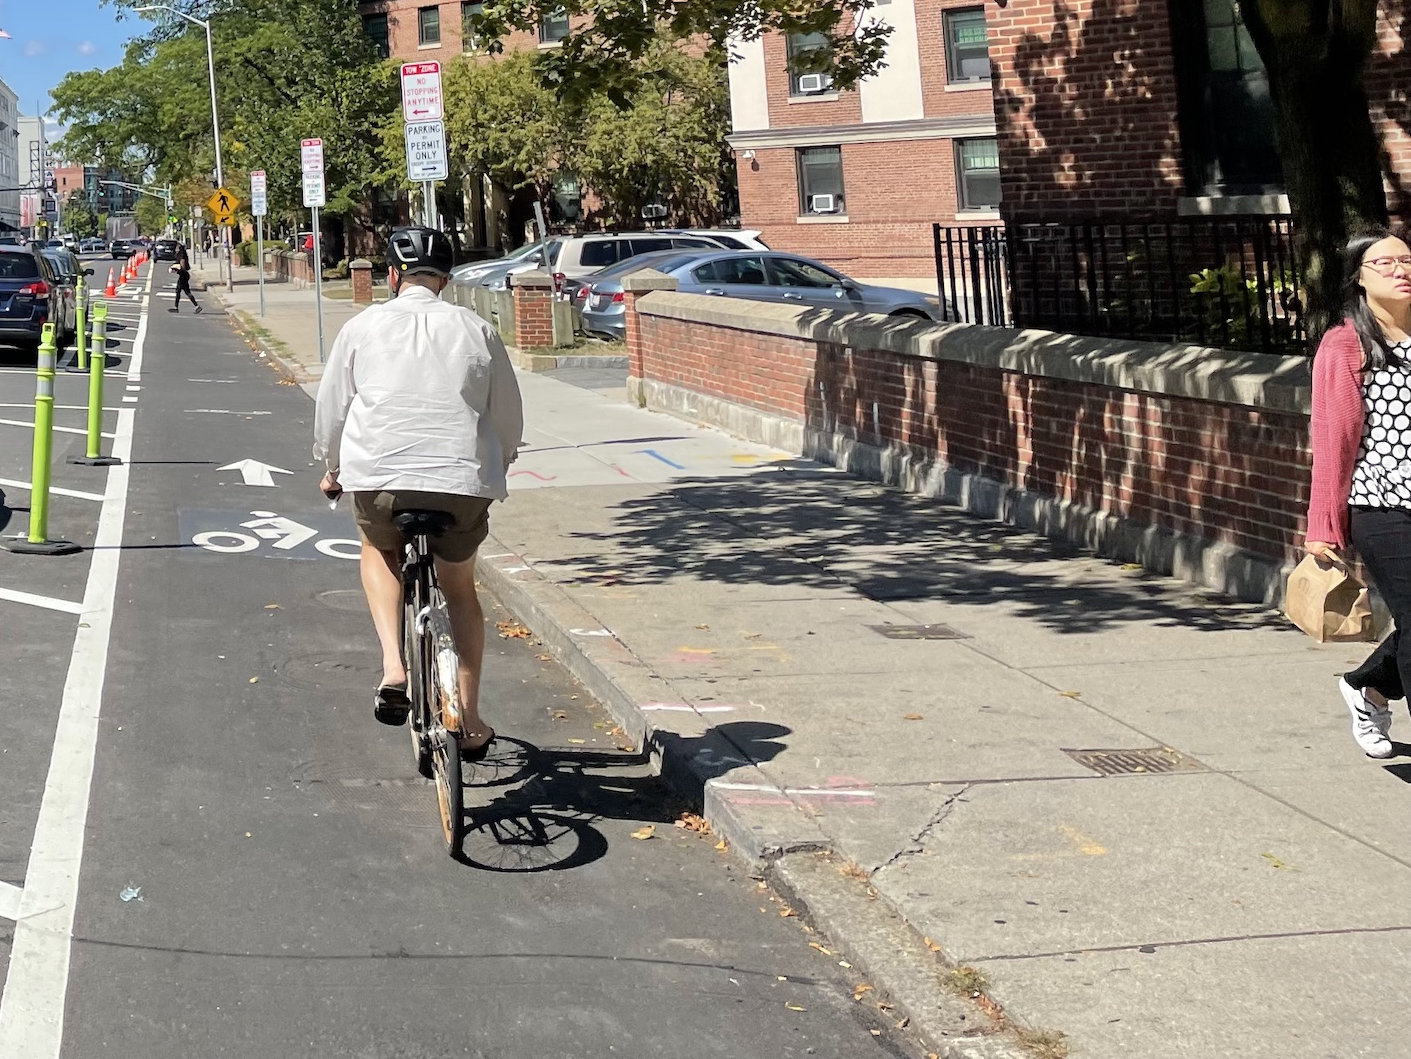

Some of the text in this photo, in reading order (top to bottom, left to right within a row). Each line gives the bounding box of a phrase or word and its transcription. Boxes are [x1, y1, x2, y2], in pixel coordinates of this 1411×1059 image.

[405, 63, 437, 74] TOW ZONE
[416, 77, 426, 85] NO
[406, 87, 438, 96] STOPPING
[407, 97, 439, 106] ANYTIME
[408, 124, 441, 135] PARKING
[410, 140, 440, 150] PERMIT
[415, 150, 437, 160] ONLY
